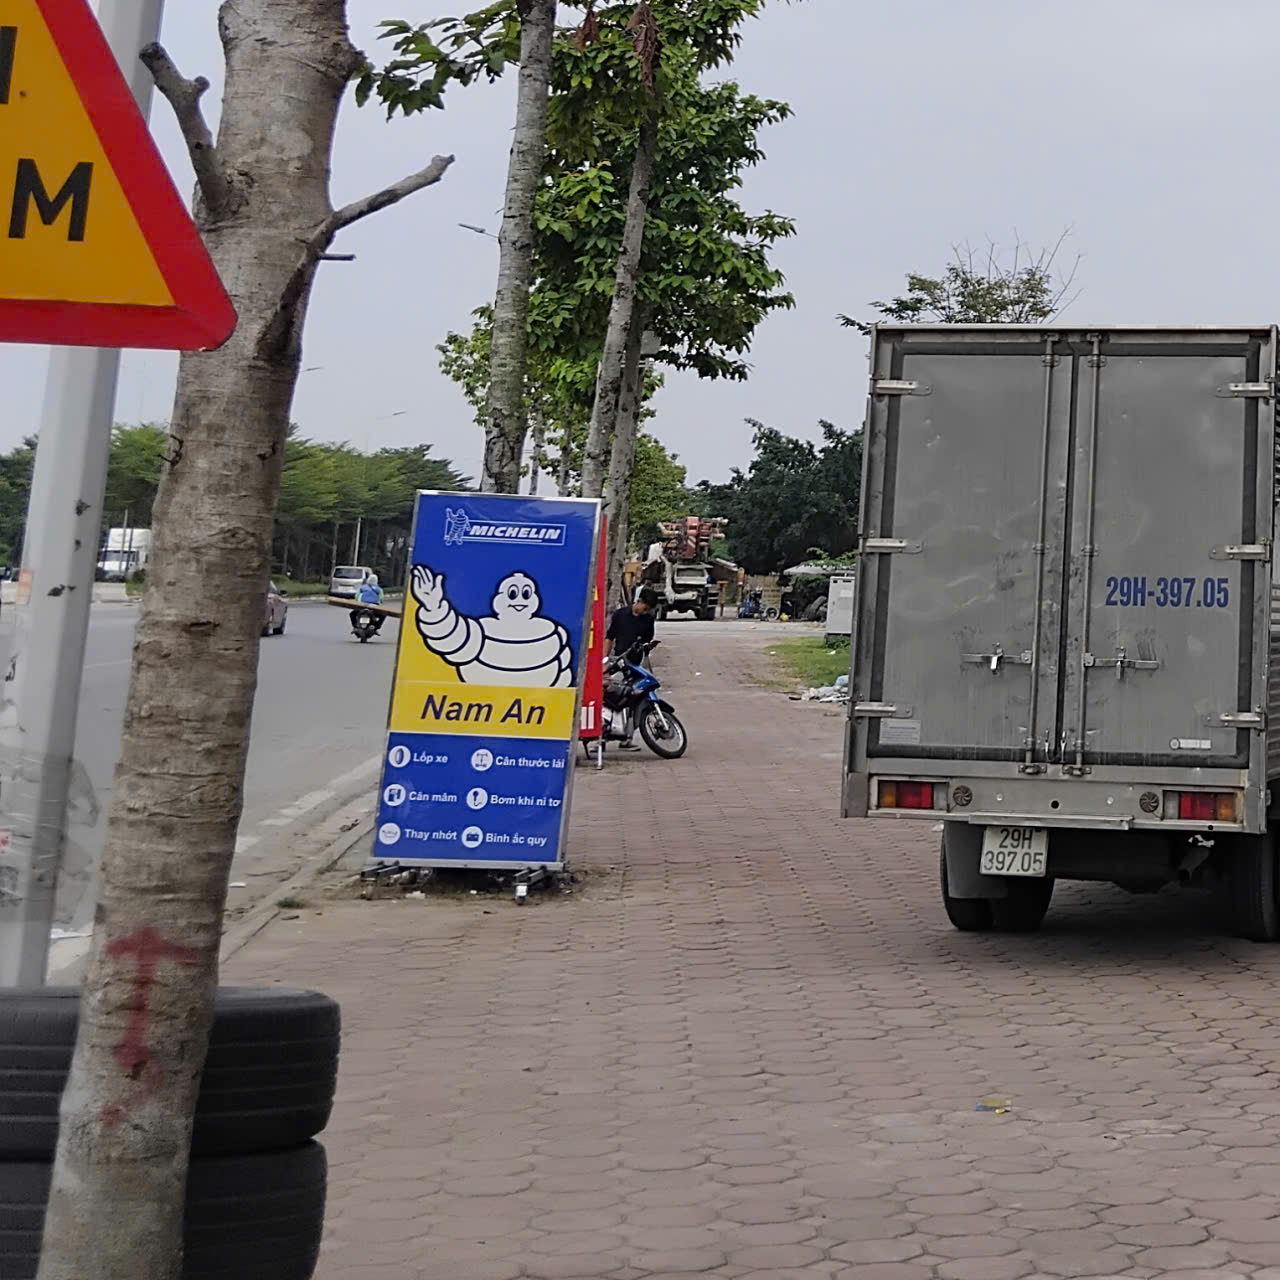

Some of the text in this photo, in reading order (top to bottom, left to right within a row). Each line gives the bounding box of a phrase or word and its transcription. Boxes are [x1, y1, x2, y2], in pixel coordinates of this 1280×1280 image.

[469, 524, 561, 540] MICHELIN
[1105, 576, 1230, 608] 29H-397.05
[421, 693, 493, 721] Nam
[500, 698, 546, 725] An
[413, 751, 448, 763] Lốp xe
[495, 755, 565, 769] Cân thước lái
[408, 790, 457, 802] Cân mâm
[490, 794, 516, 806] Bơm
[405, 828, 457, 841] Thay nhớt
[527, 836, 547, 847] quy
[999, 828, 1033, 849] 29H
[983, 850, 1044, 872] 397.05
